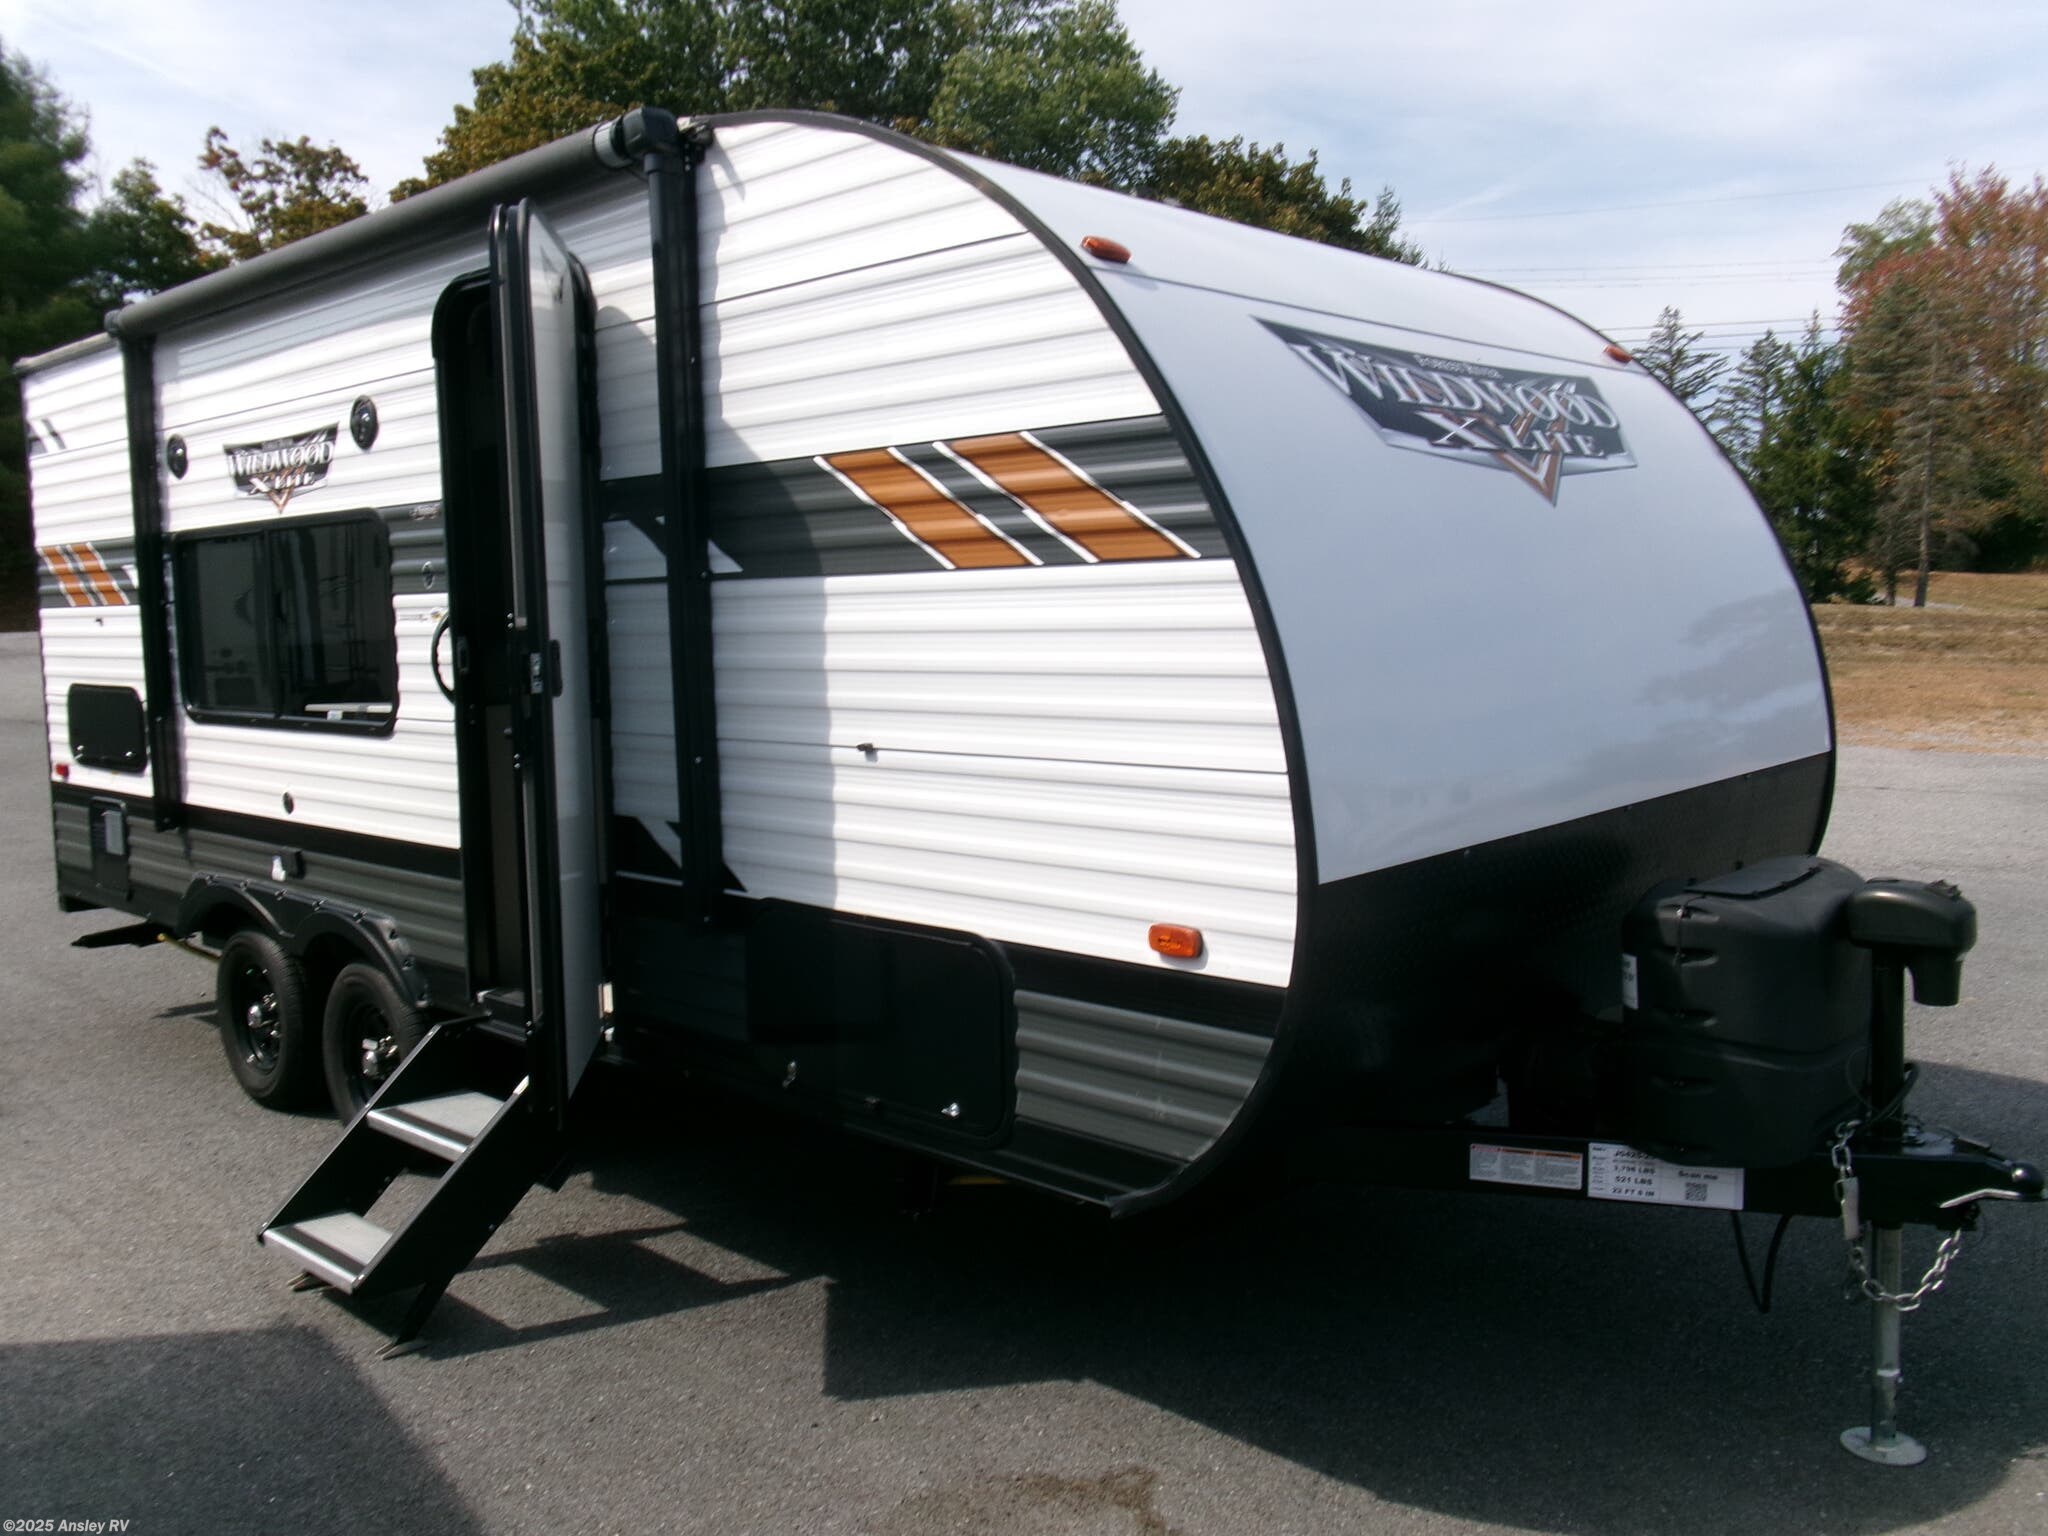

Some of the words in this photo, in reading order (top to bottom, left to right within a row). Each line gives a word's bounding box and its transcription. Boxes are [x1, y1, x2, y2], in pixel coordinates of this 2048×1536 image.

[1287, 343, 1619, 430] WILDWOOD
[1500, 423, 1605, 458] LITE
[227, 441, 334, 475] WILDWOOD
[274, 471, 315, 490] LITE
